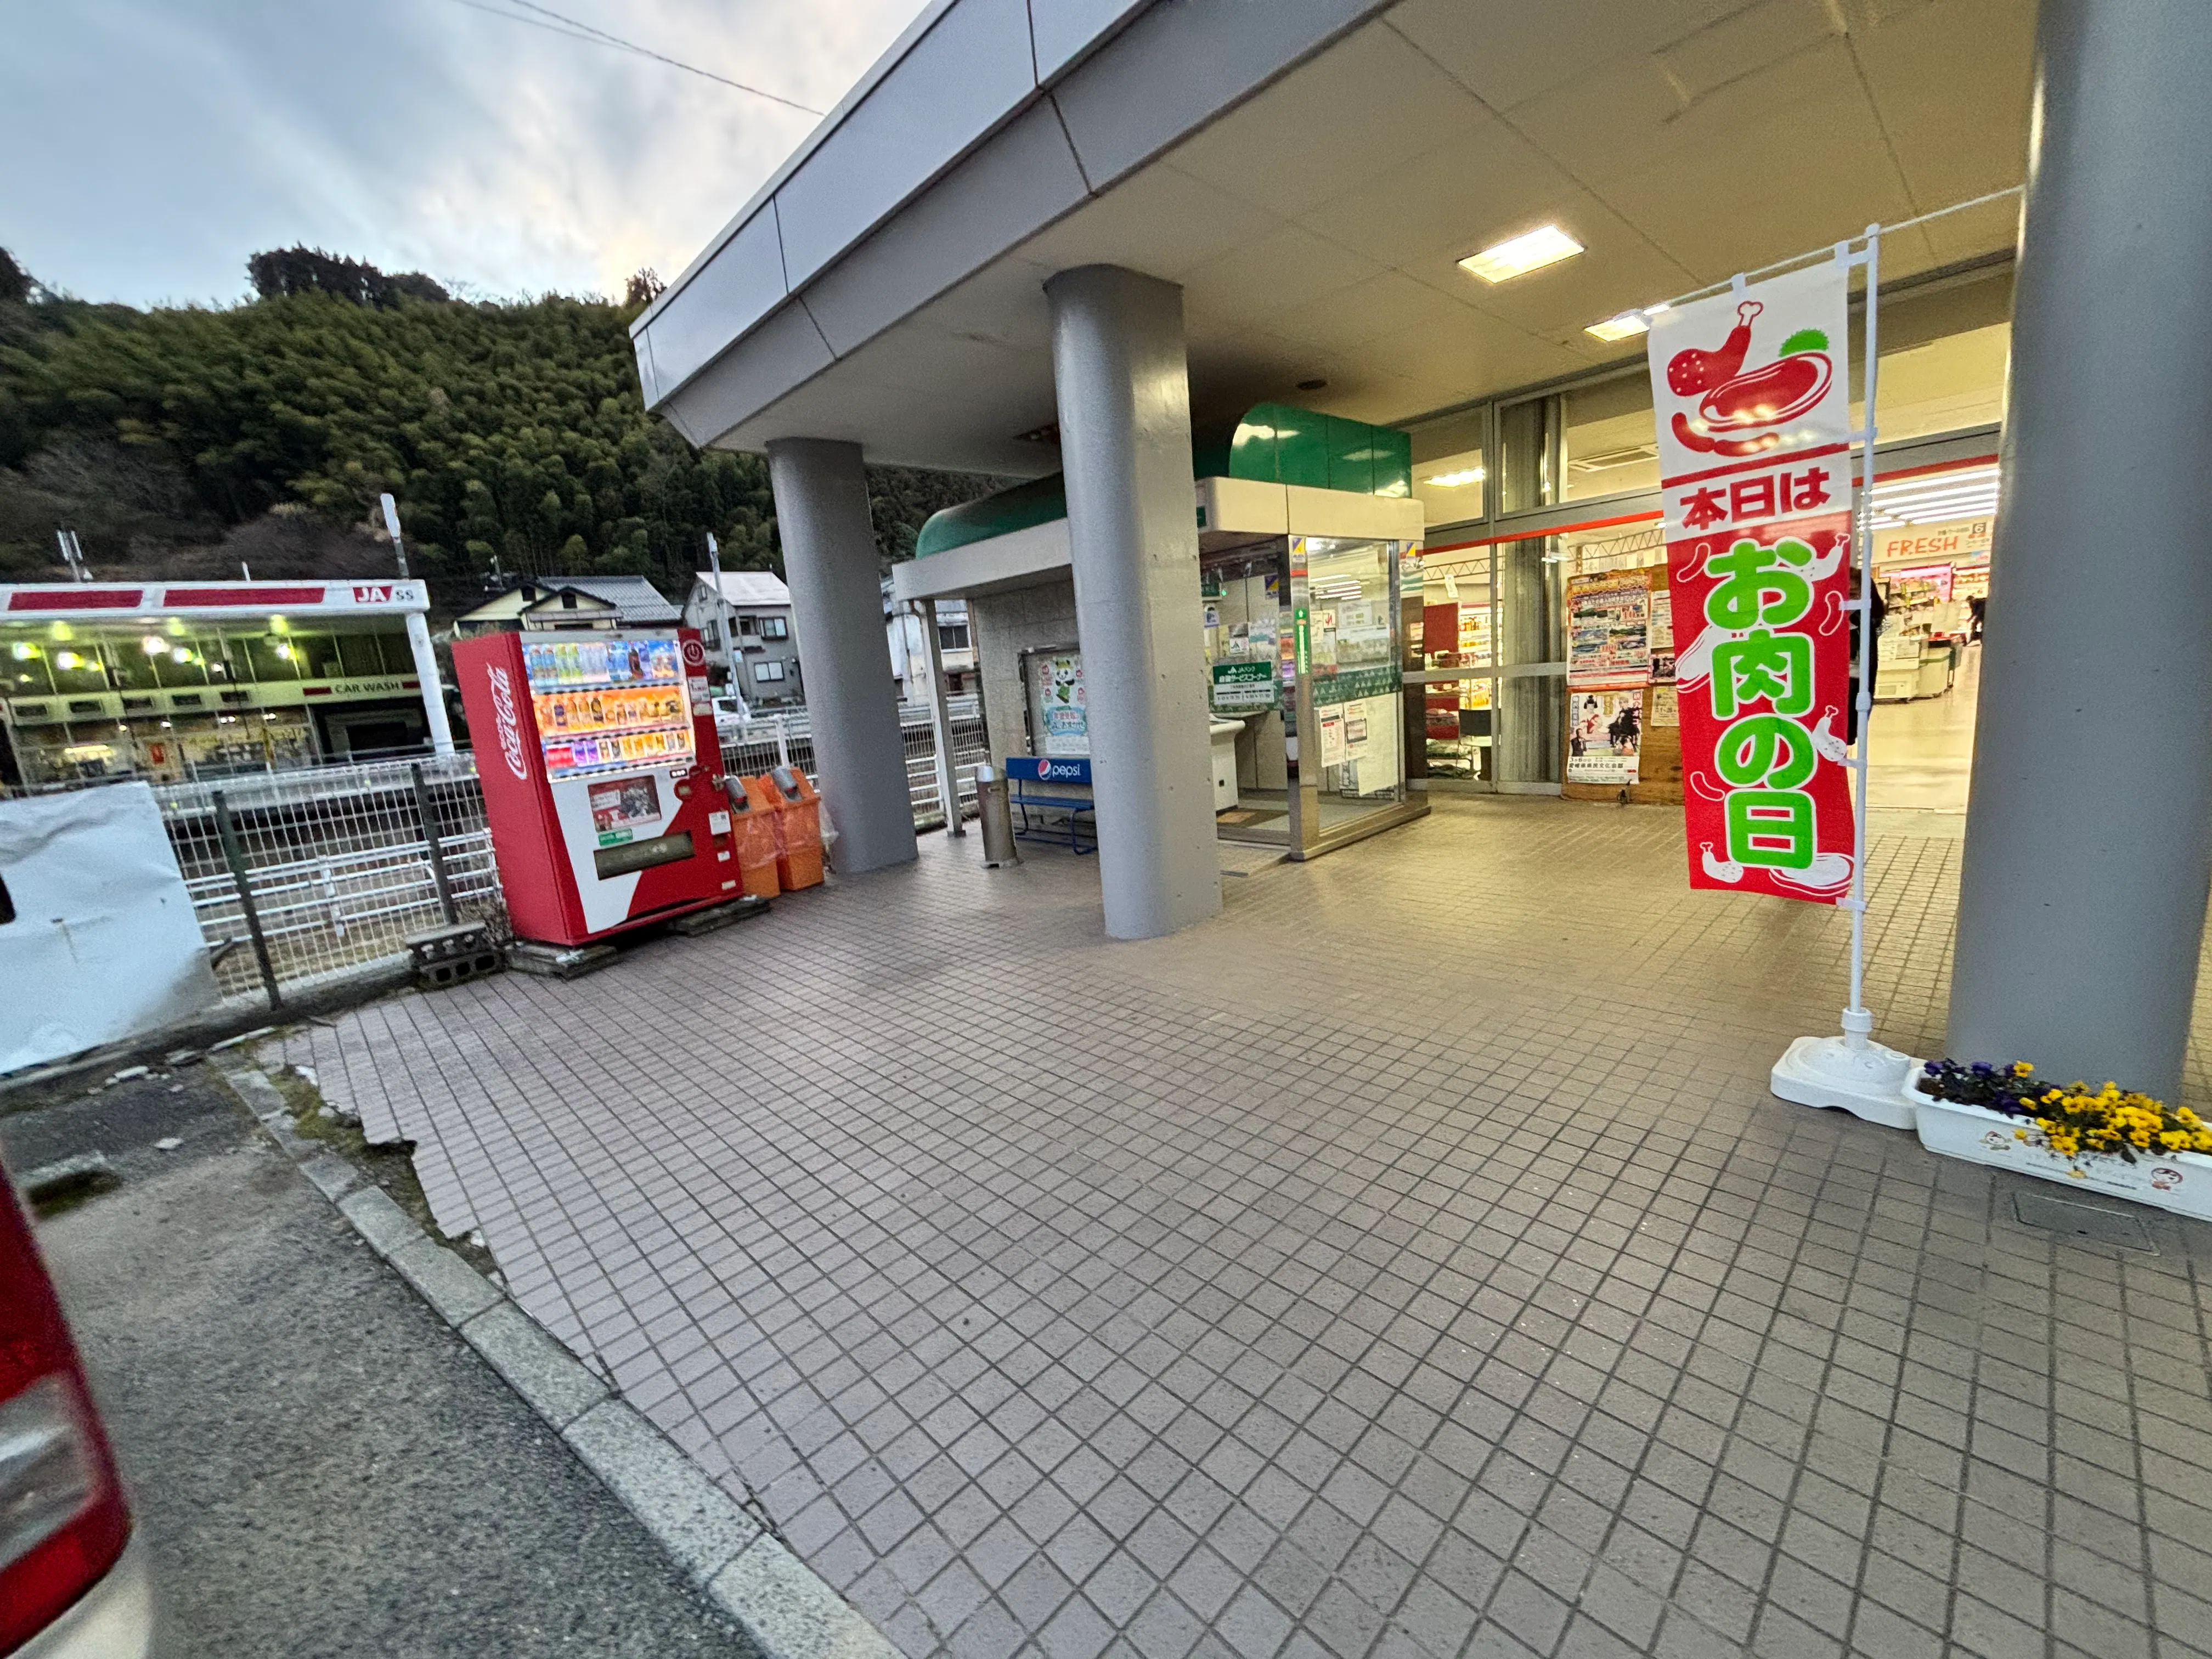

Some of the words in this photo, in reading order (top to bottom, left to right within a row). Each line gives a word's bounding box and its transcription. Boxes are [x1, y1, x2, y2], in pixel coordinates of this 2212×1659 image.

[1680, 467, 1831, 531] 本日は
[1887, 536, 1958, 557] FRESH
[358, 587, 387, 602] JA
[335, 684, 360, 694] CAR
[364, 682, 399, 691] WASH
[1705, 538, 1818, 871] お肉の日
[486, 661, 527, 780] Coca-Cola
[1052, 763, 1081, 778] pepsi
